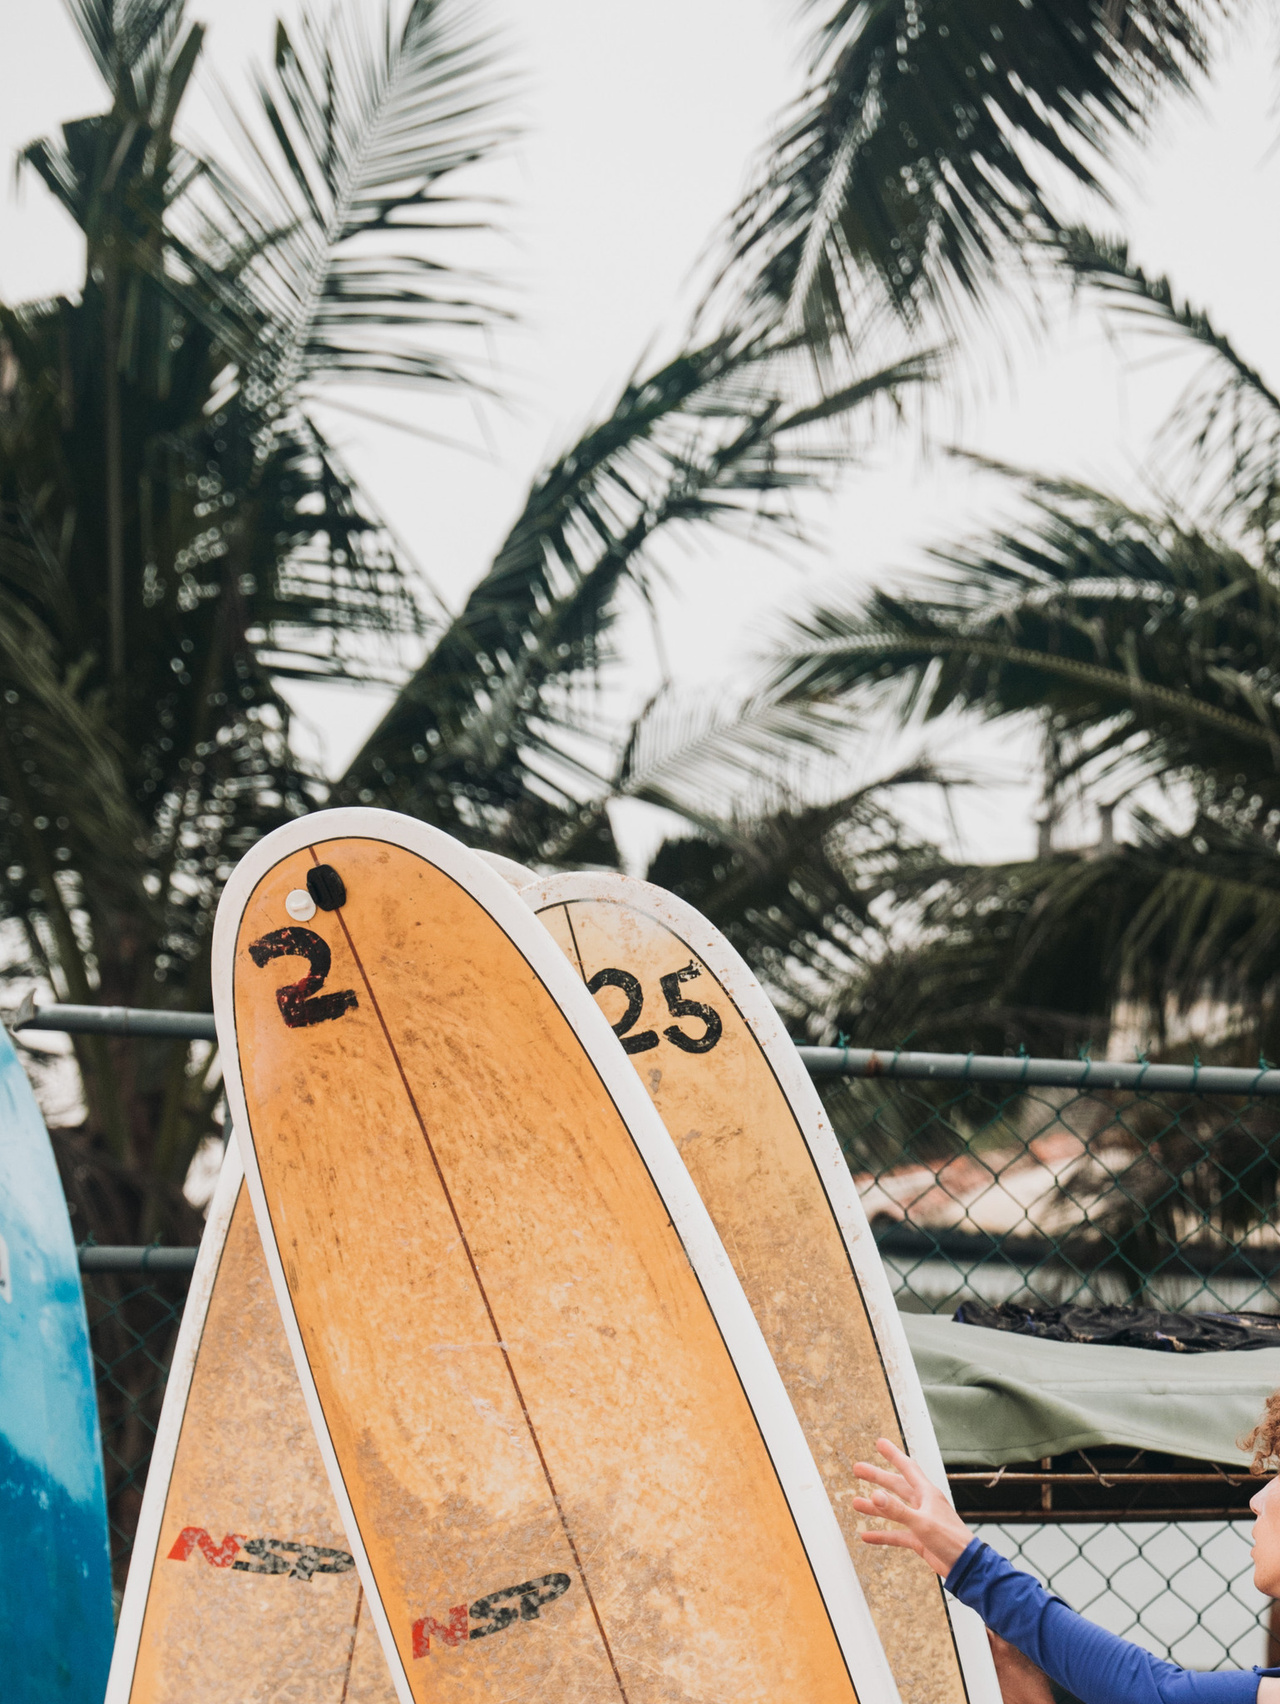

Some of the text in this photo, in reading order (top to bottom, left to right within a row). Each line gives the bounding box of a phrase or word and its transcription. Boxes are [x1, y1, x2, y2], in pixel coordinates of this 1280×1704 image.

[249, 926, 359, 1028] 2
[588, 958, 723, 1055] 25
[167, 1526, 356, 1582] NSP
[412, 1572, 571, 1659] NSP
